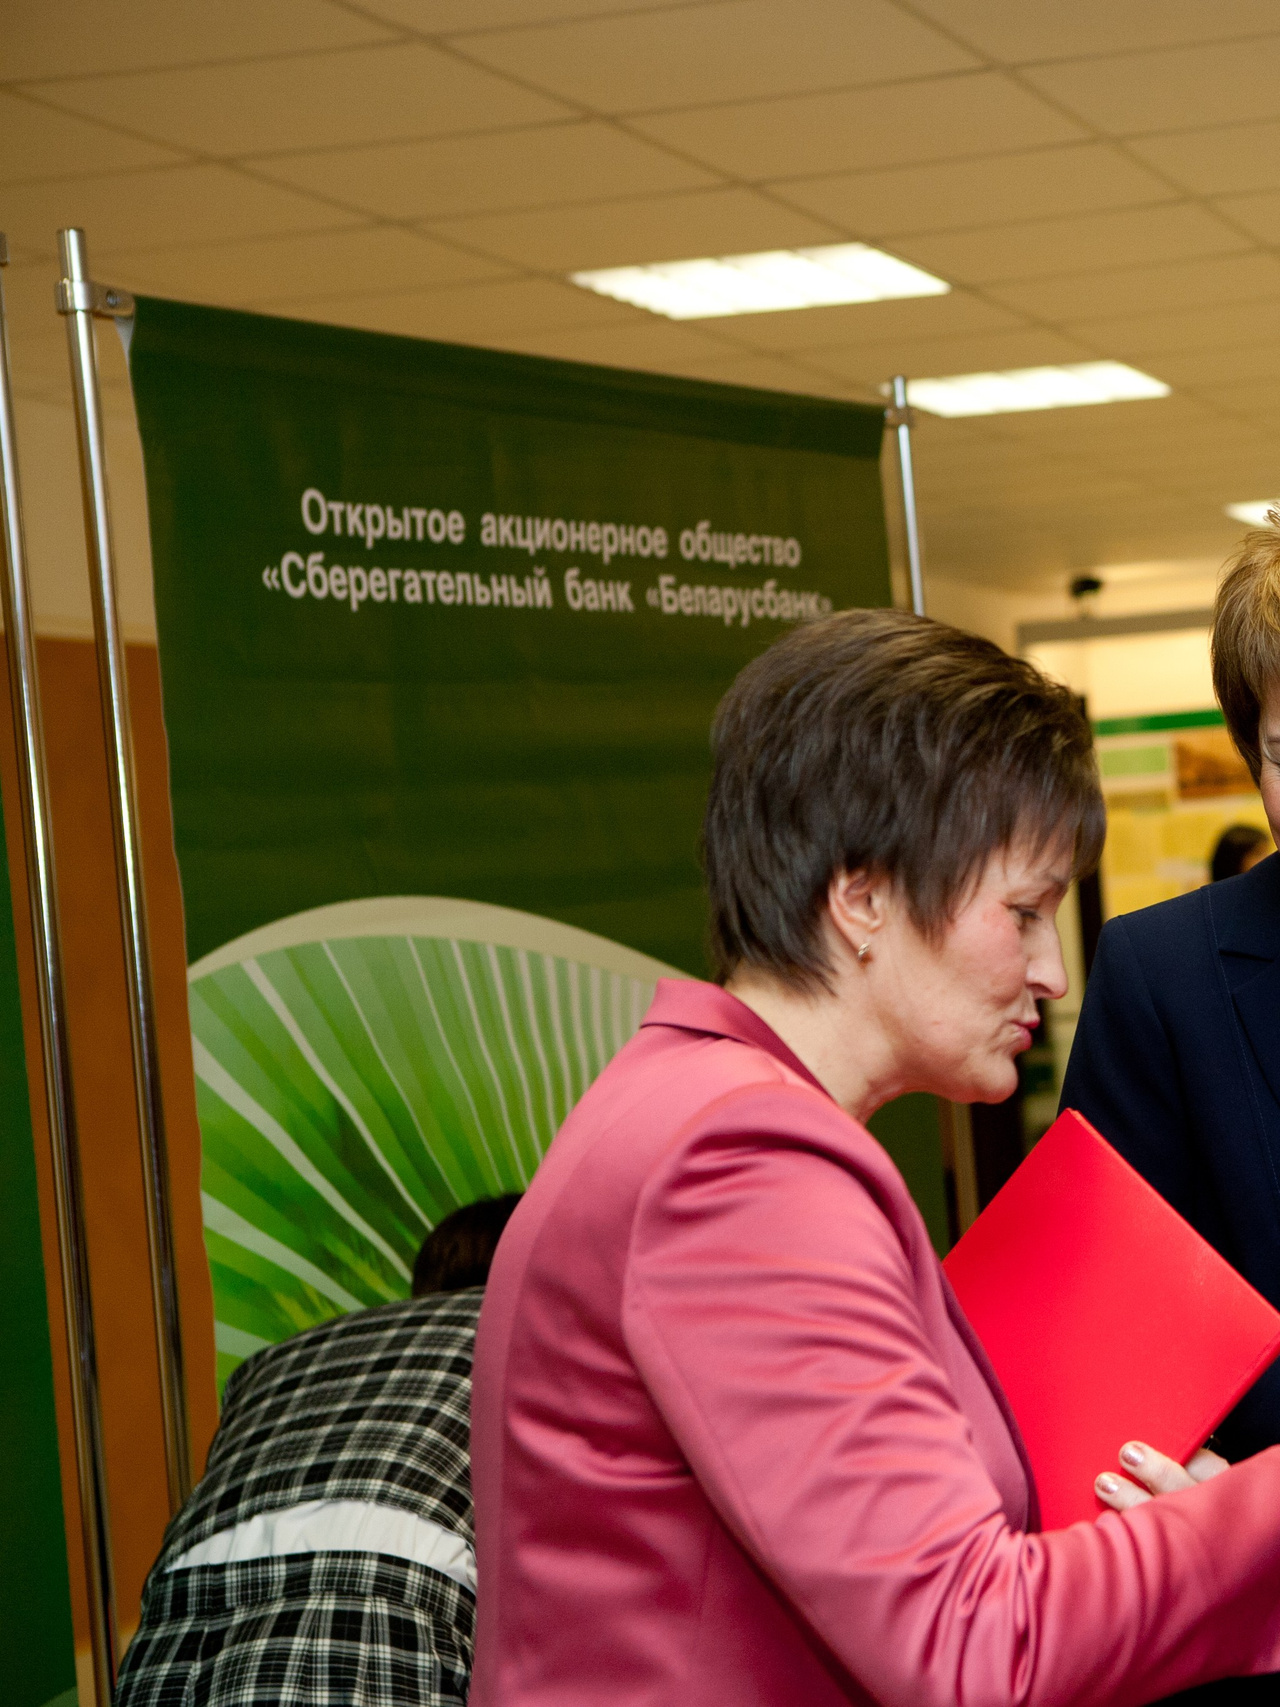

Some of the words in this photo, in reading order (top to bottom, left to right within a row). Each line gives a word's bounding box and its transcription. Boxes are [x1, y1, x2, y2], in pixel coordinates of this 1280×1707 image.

[301, 487, 466, 549] Открытое
[480, 511, 669, 564] акционерное
[679, 520, 802, 568] общество
[262, 551, 552, 612] «Сберегательный
[564, 567, 635, 612] банк
